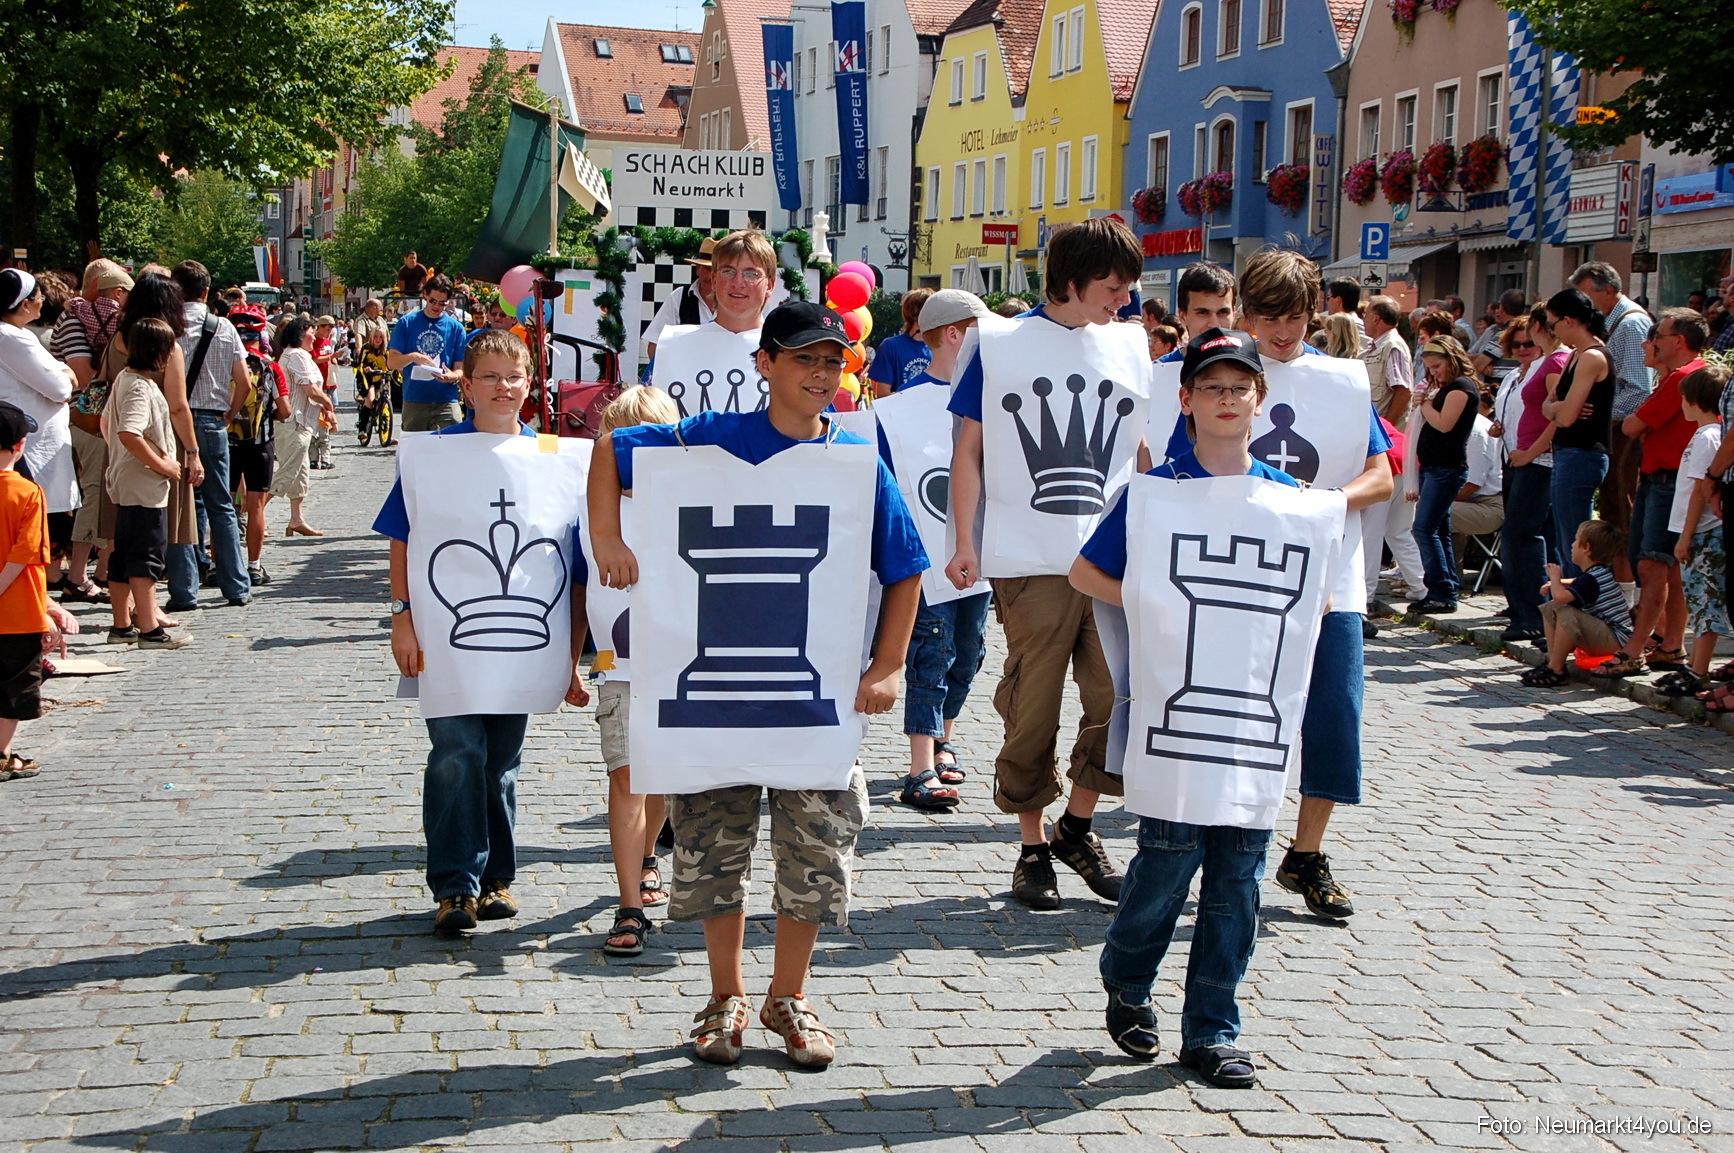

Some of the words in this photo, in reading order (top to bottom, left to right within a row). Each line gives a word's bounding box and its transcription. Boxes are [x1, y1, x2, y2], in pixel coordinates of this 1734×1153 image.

[851, 78, 865, 149] RUPPERT
[961, 129, 985, 154] HOTEL
[855, 151, 866, 180] K&L
[653, 176, 745, 198] Neumarkt
[1618, 165, 1632, 235] KINO
[955, 243, 989, 260] Restaurant
[1367, 227, 1384, 256] P
